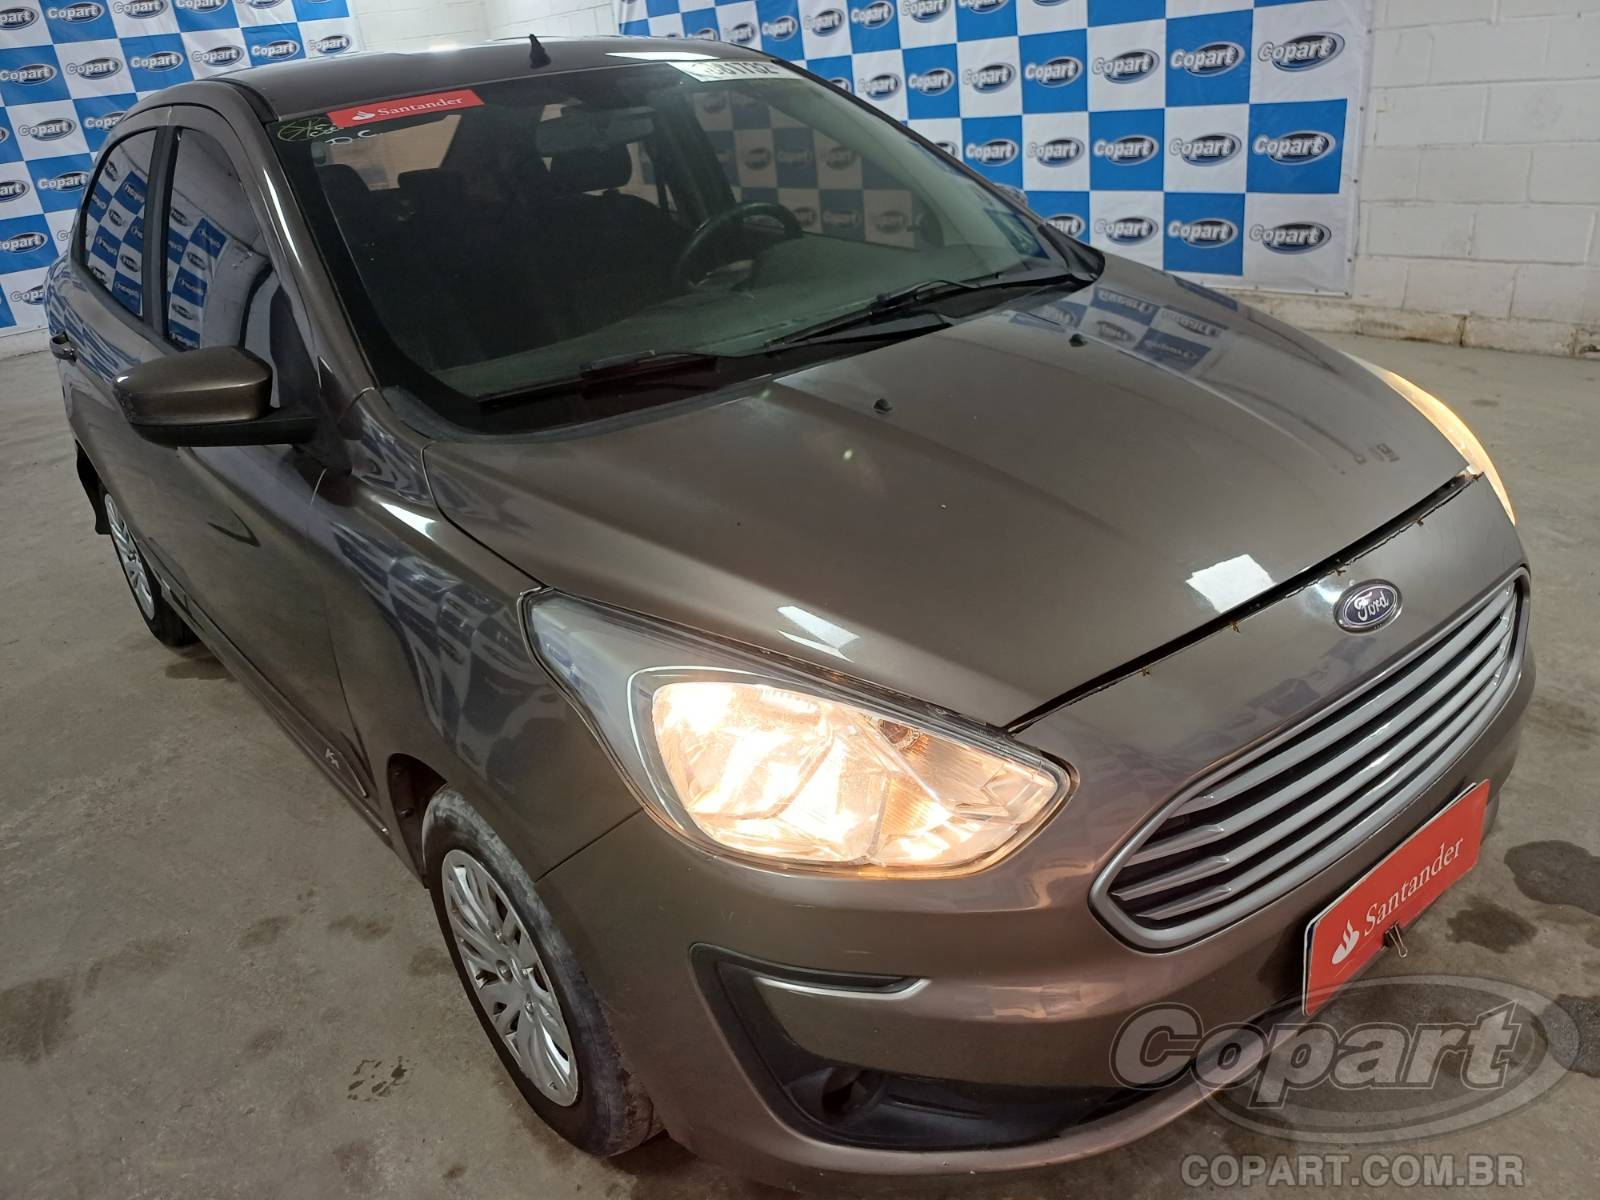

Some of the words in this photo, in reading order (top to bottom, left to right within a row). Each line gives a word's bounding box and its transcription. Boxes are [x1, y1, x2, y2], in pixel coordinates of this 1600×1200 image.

[48, 6, 98, 21] Copart
[113, 0, 163, 13] Copart
[251, 43, 296, 57] Copart
[308, 38, 348, 51] Copart
[1258, 37, 1334, 62] Copart
[130, 53, 178, 69] Copart
[192, 49, 238, 63] Copart
[1092, 53, 1151, 76] Copart
[1171, 45, 1236, 70] Copart
[0, 66, 50, 82] Copart
[66, 60, 116, 75] Copart
[964, 66, 1011, 86] Copart
[1025, 60, 1077, 81] Copart
[908, 71, 950, 91] Copart
[377, 96, 464, 117] Santander
[19, 121, 71, 138] Copart
[84, 115, 120, 130] Copa
[966, 142, 1017, 161] Copart
[1028, 141, 1078, 160] Copart
[1093, 139, 1151, 160] Copart
[1169, 137, 1233, 160] Copart
[1253, 133, 1325, 160] Copart
[38, 173, 87, 189] Copart
[1095, 219, 1150, 239] Copart
[1167, 219, 1230, 243] Copart
[1250, 224, 1321, 247] Copart
[1354, 591, 1389, 622] Ford
[1363, 837, 1464, 937] Santander
